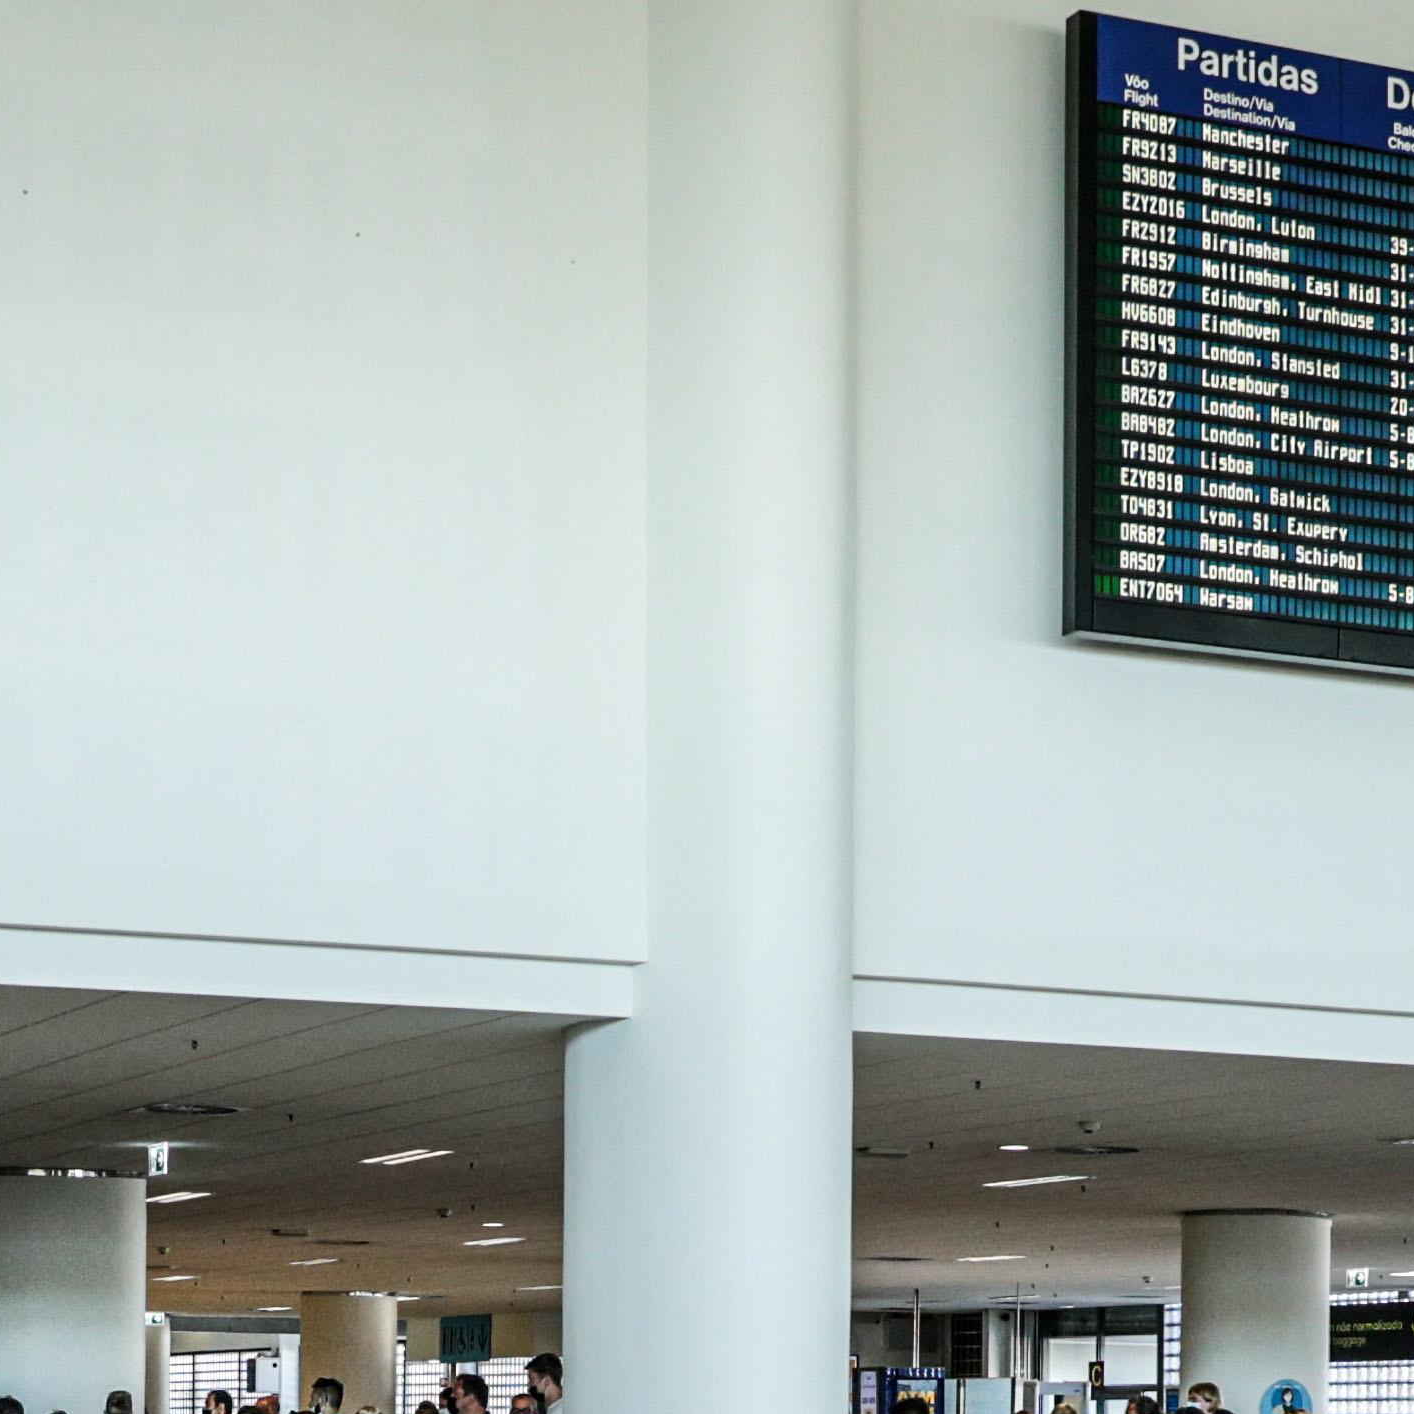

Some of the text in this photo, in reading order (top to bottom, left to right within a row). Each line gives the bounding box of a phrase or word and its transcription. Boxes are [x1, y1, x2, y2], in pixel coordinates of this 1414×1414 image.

[1177, 37, 1319, 96] Partidas
[1125, 73, 1150, 90] Vôo
[1203, 88, 1274, 113] Destino/Via
[1124, 90, 1159, 108] Flight
[1203, 104, 1296, 132] Destination/Via
[1203, 124, 1289, 154] Manchester
[1203, 151, 1280, 180] Marseille
[1203, 178, 1272, 206] Brussels
[1123, 219, 1175, 244] FR2912
[1202, 232, 1289, 262] Birmingham
[1272, 217, 1315, 240] Luton
[1123, 246, 1176, 271] FR1957
[1306, 276, 1338, 298] East
[1349, 283, 1381, 304] Midl
[1202, 313, 1280, 342] Eindhoven
[1299, 302, 1374, 330] Turnhouse
[1272, 352, 1339, 379] Stansted
[1122, 385, 1175, 408] BA2627
[1271, 406, 1339, 432] Heathrow
[1390, 424, 1414, 444] 5-8
[1201, 451, 1253, 475] Lisboa
[1271, 433, 1305, 455] City
[1314, 440, 1371, 464] Airport
[1390, 451, 1414, 470] 5-8
[1270, 487, 1330, 512] Gatwick
[1200, 588, 1253, 611] Warsaw
[1270, 569, 1338, 594] Heathrow
[1389, 584, 1414, 604] 5-8
[1091, 1365, 1102, 1386] C
